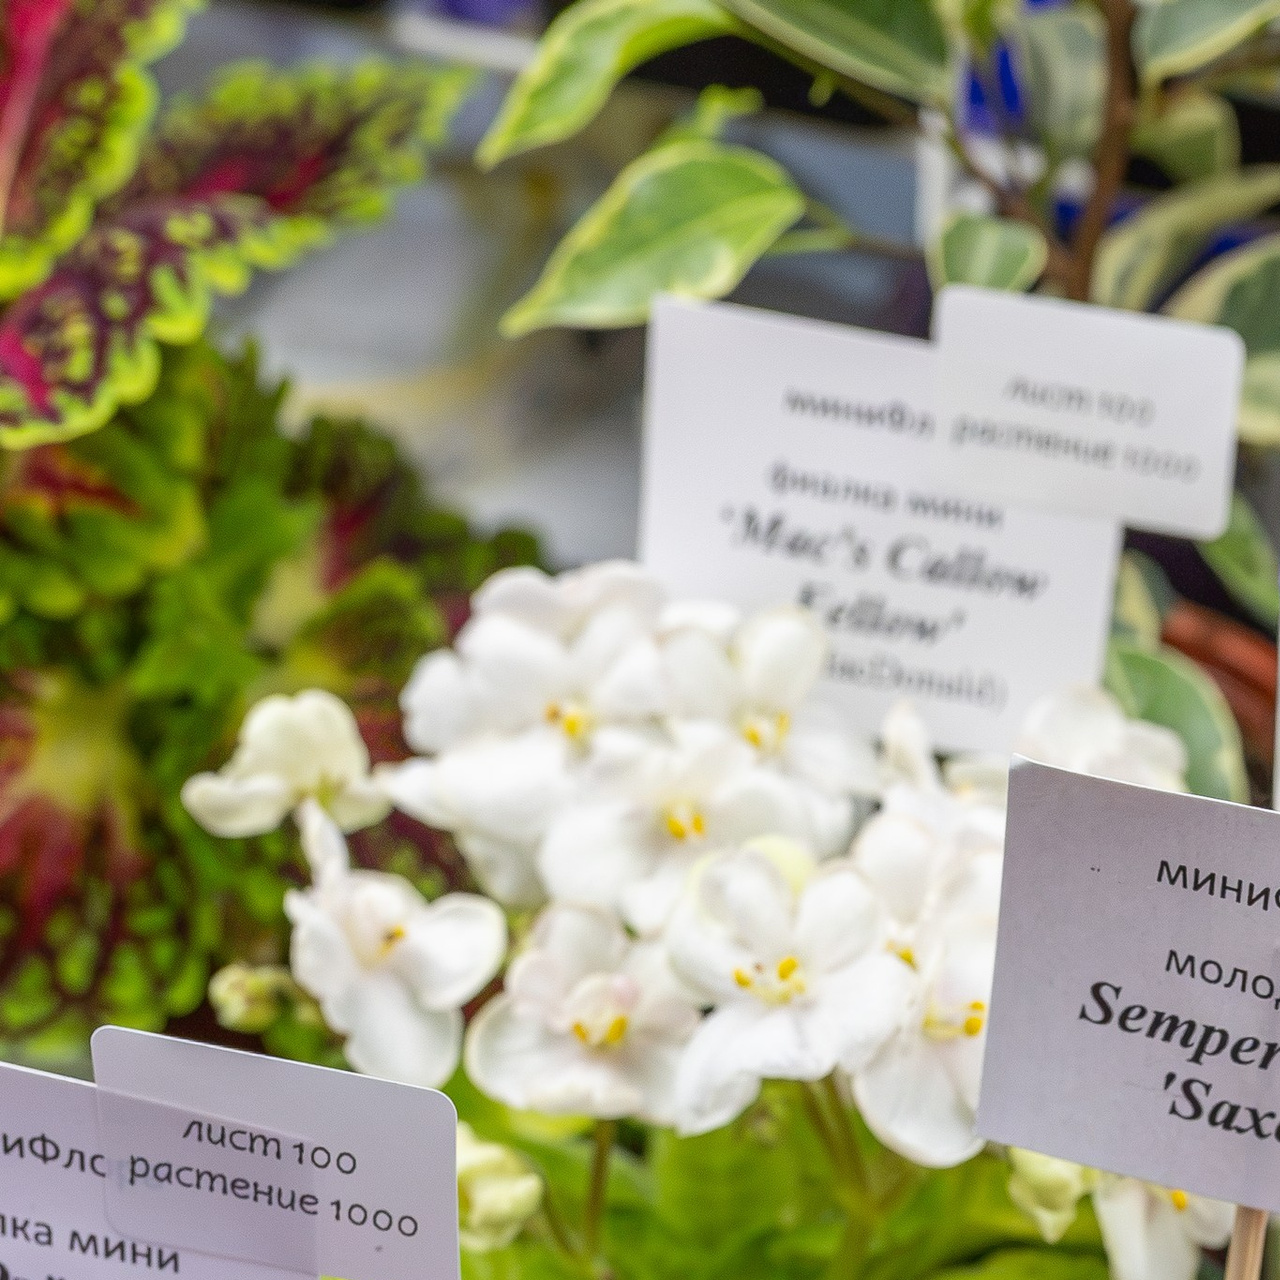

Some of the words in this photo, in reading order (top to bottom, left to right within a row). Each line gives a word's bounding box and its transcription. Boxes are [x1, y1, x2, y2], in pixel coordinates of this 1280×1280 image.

[181, 1119, 281, 1160] лист
[294, 1142, 357, 1175] 100
[129, 1153, 318, 1215] растение
[331, 1199, 419, 1237] 1000
[69, 1230, 180, 1274] мини
